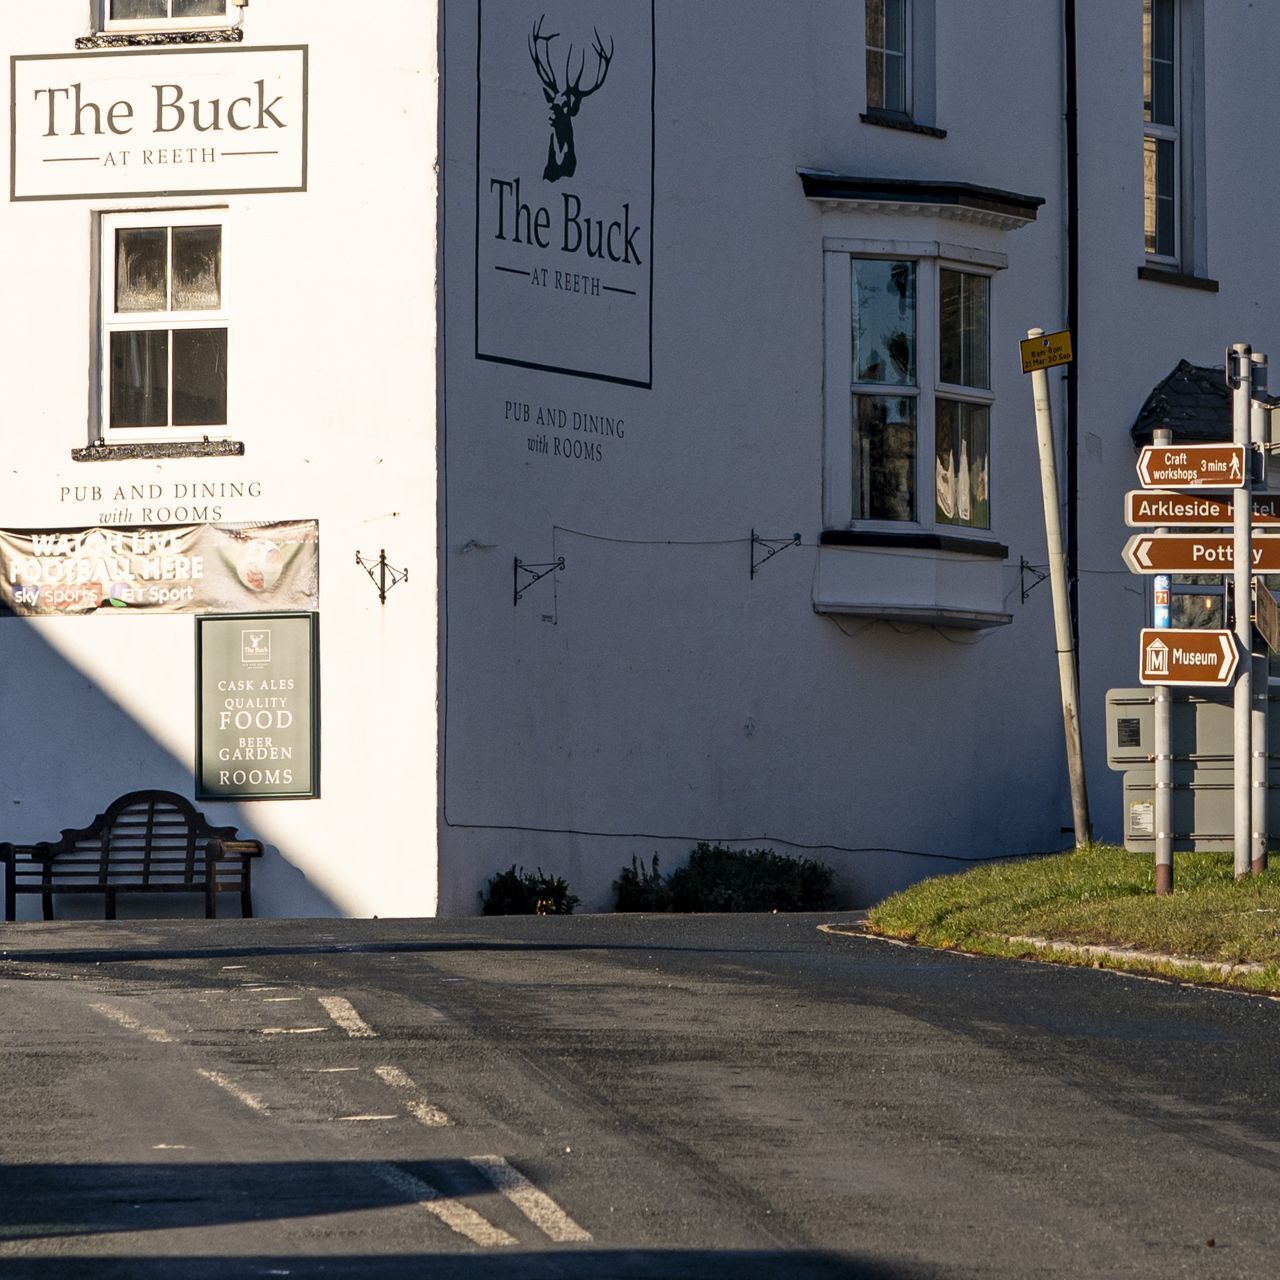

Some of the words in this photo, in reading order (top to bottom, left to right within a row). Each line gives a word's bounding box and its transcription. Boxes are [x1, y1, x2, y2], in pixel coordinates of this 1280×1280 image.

[34, 82, 134, 137] The
[152, 79, 287, 133] Buck
[104, 150, 130, 166] AT
[143, 148, 216, 165] REETH
[490, 177, 550, 248] The
[561, 192, 642, 266] Buck
[531, 268, 548, 287] AT
[555, 271, 600, 296] REETH
[505, 400, 530, 422] PUB
[536, 407, 567, 429] AND
[573, 412, 625, 438] DINING
[528, 434, 549, 454] with
[554, 437, 602, 462] ROOMS
[1164, 452, 1187, 465] Craft
[1200, 459, 1207, 471] 3
[1208, 460, 1227, 471] mins
[1153, 468, 1198, 481] workshops
[60, 486, 102, 501] PUB
[114, 485, 162, 500] AND
[174, 482, 261, 499] DINING
[99, 507, 132, 524] with
[142, 505, 222, 522] ROOMS
[1138, 500, 1220, 516] Arkleside
[1227, 501, 1276, 516] Htel
[31, 531, 124, 557] WATCH
[132, 531, 182, 555] LIVE
[1192, 544, 1263, 564] Potty
[10, 557, 136, 583] FOOTBALL
[144, 556, 204, 581] HERE
[14, 587, 40, 606] sky
[45, 588, 98, 606] sports
[122, 589, 147, 600] BT
[149, 587, 193, 602] Sport
[1156, 592, 1168, 605] 71
[1172, 648, 1218, 665] Museum
[218, 680, 254, 691] CASK
[260, 679, 294, 690] ALES
[224, 697, 287, 710] QUALITY
[219, 710, 292, 730] FOOD
[239, 737, 272, 747] BEER
[219, 747, 292, 760] GARDEN
[219, 769, 293, 785] ROOMS
